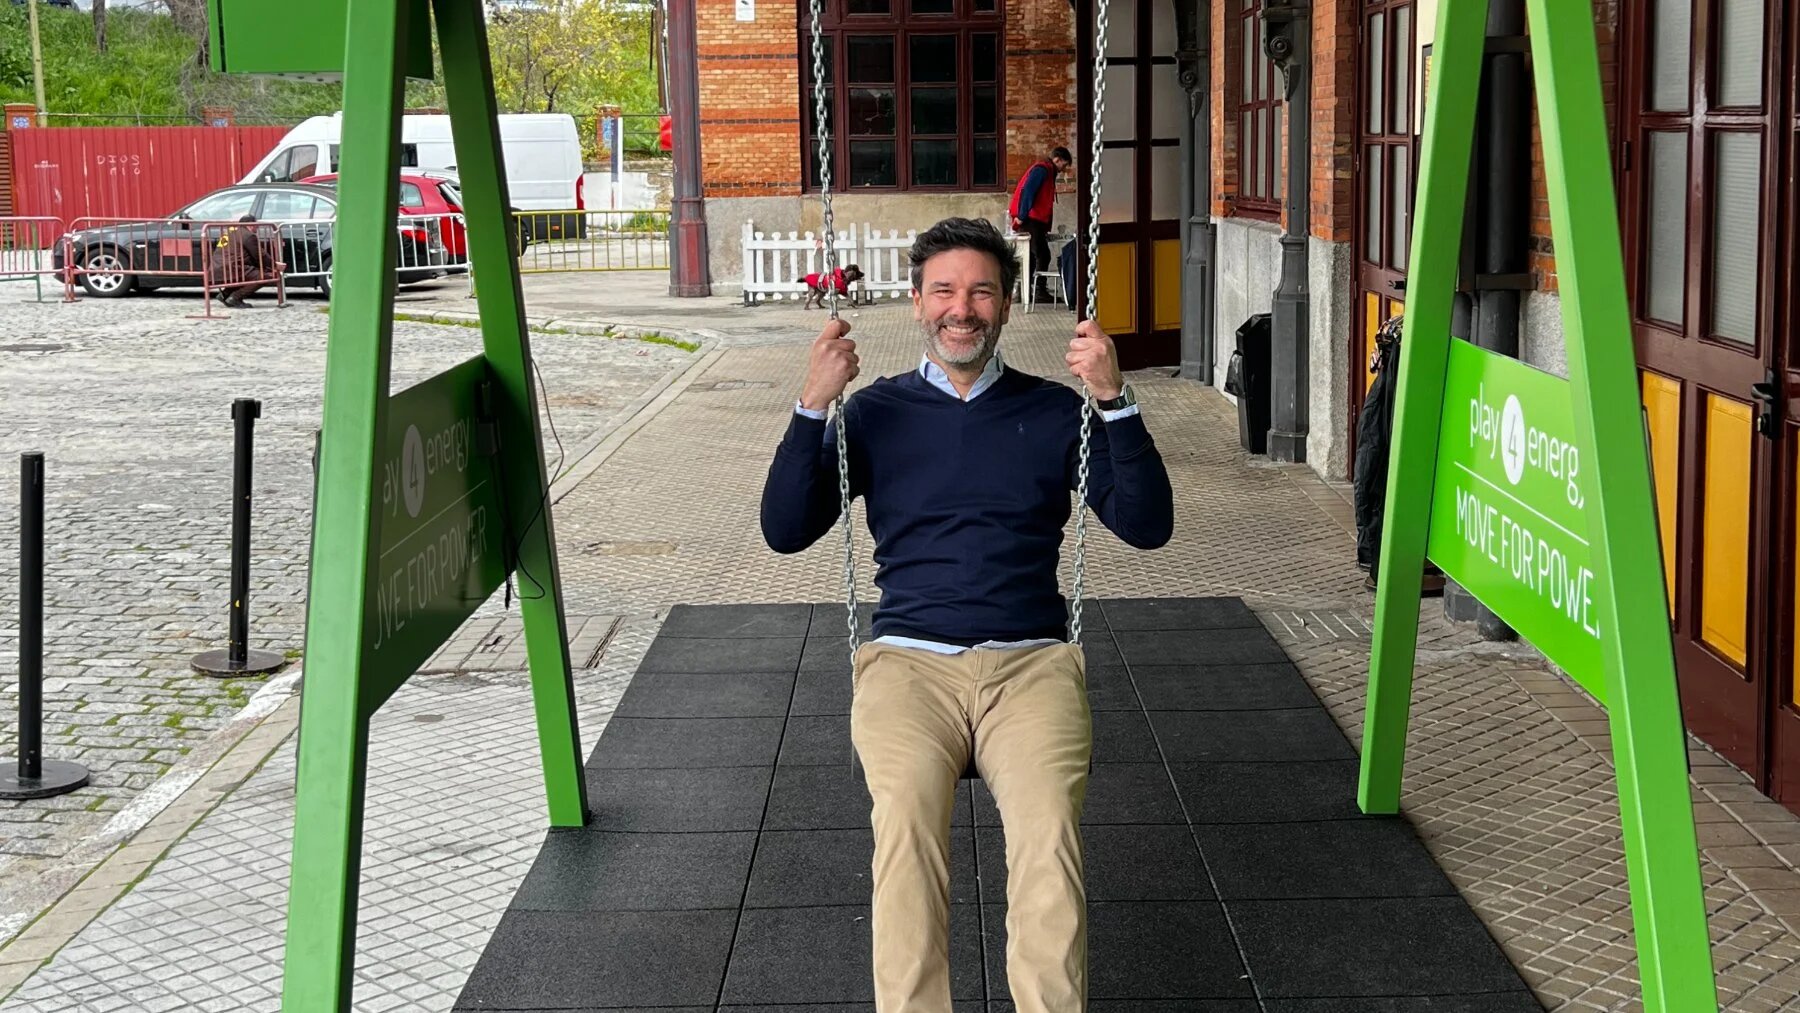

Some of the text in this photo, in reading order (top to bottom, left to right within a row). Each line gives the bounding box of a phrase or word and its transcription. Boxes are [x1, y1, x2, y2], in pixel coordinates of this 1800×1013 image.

[97, 154, 140, 166] DIOS
[383, 456, 400, 518] ay
[426, 415, 470, 475] energy
[1470, 382, 1500, 460] play
[407, 544, 438, 619] FOR
[440, 505, 487, 591] POWER
[1456, 485, 1600, 640] MOVE FOR POWE
